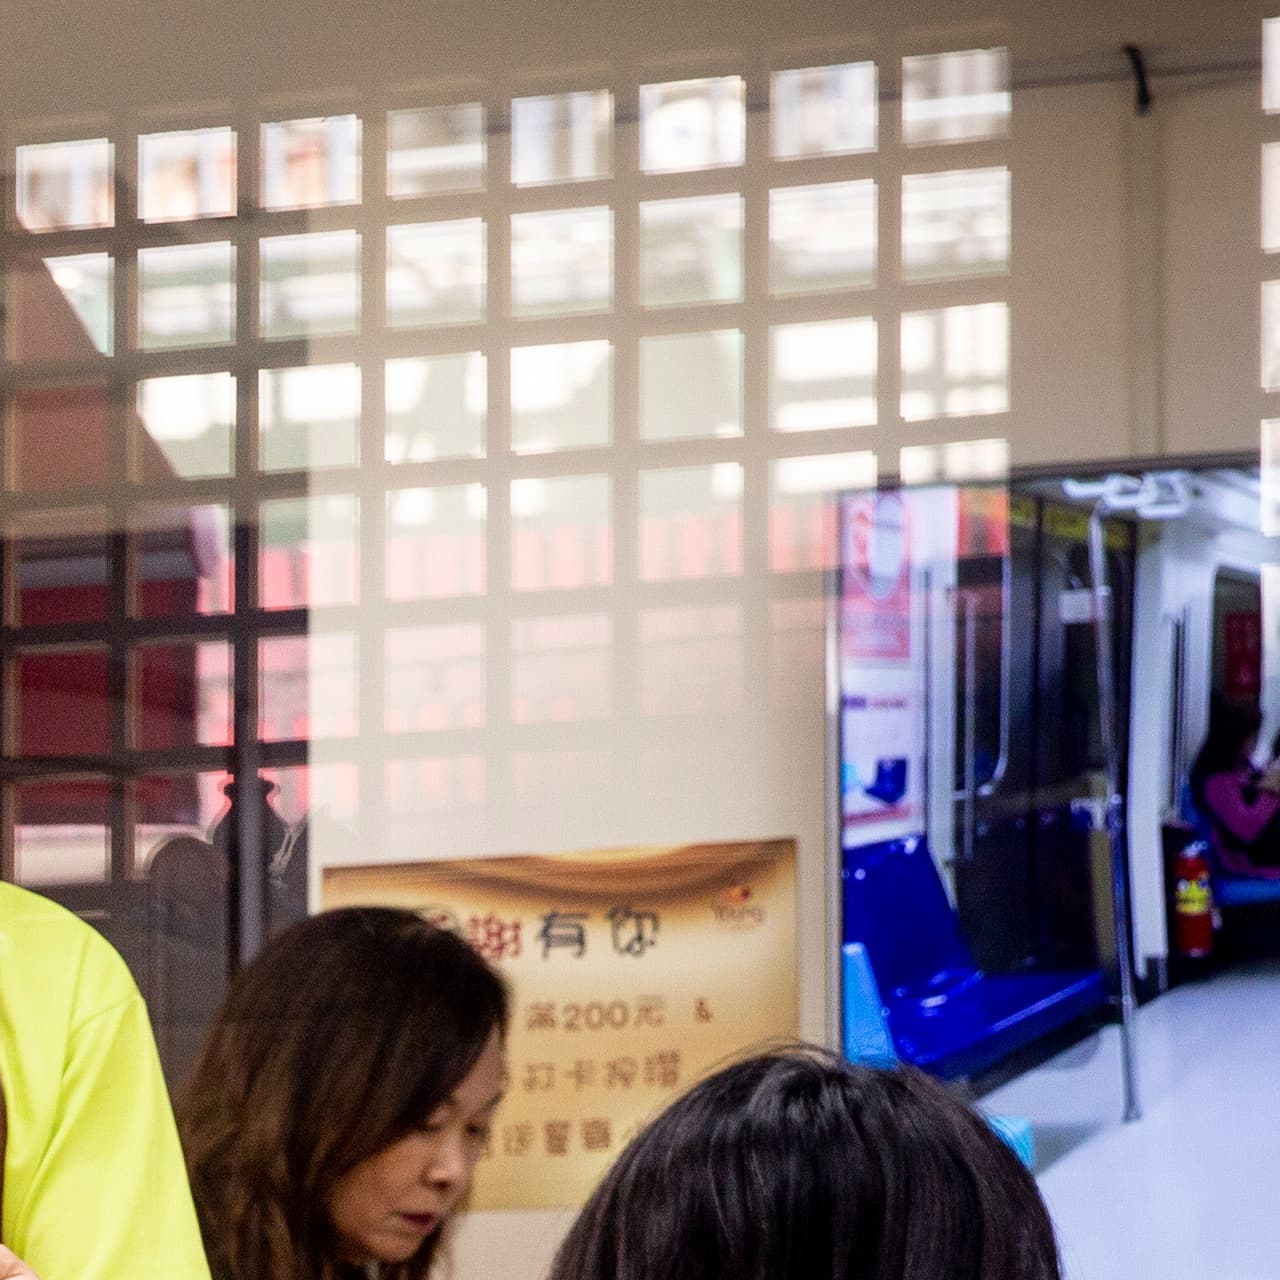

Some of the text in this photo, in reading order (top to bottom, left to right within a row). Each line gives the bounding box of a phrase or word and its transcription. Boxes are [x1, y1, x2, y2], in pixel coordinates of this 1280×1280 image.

[430, 904, 661, 961] 謝有你
[502, 1049, 681, 1092] 打卡按讚
